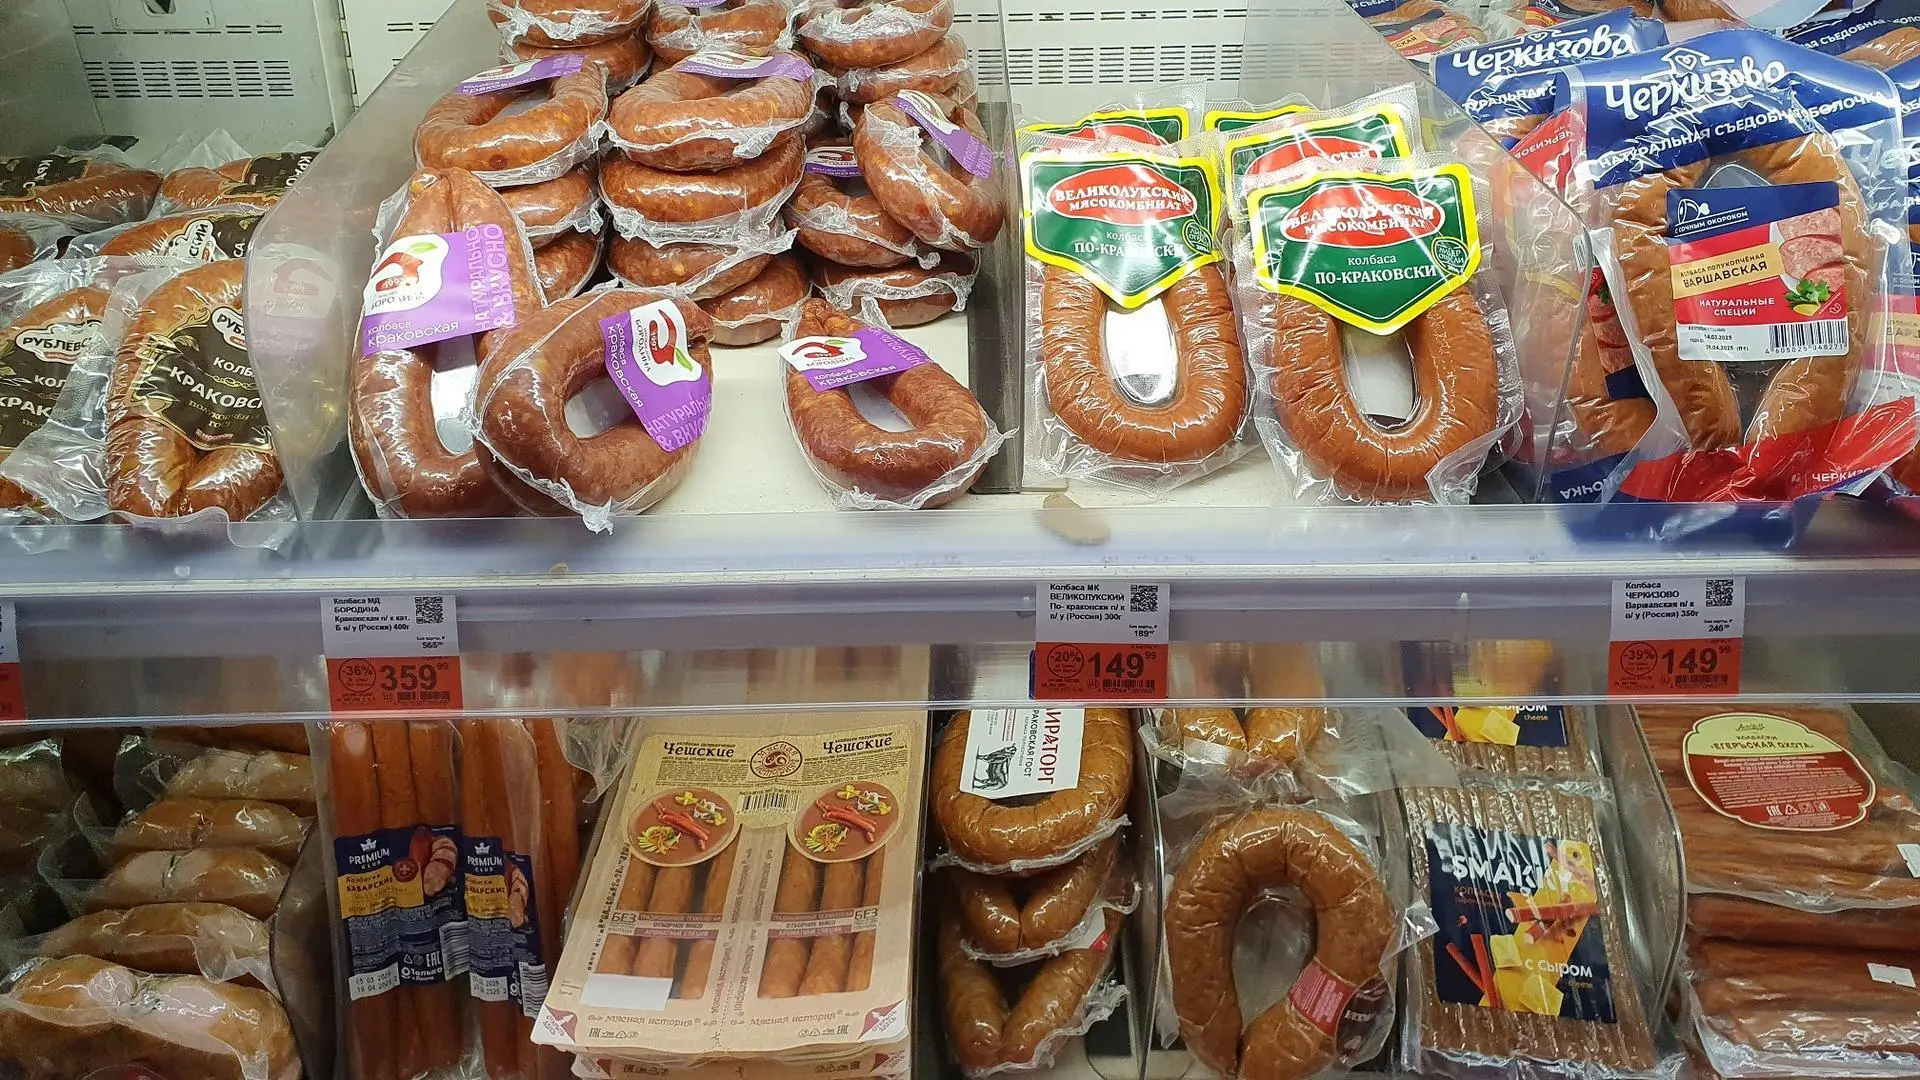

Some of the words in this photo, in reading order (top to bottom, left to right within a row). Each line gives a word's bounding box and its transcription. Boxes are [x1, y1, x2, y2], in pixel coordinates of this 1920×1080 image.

[1604, 56, 1786, 120] Черкизово
[1069, 197, 1182, 211] МЯСОКОМБИНАТ
[1707, 211, 1749, 227] ОКОРОКОМ
[1348, 254, 1397, 267] колбаса
[1314, 264, 1437, 285] ПО-КРАКОВСКИ
[1699, 297, 1775, 307] НАТУРАЛЬНЫЕ
[1714, 308, 1756, 317] СПЕЦИИ
[368, 321, 460, 347] краковская
[616, 322, 627, 366] колбаса
[608, 325, 644, 409] краковская
[818, 365, 897, 387] краковская
[1050, 583, 1085, 591] Колбаса
[1626, 581, 1661, 589] Колбаса
[1050, 592, 1125, 601] ВЕЛИКОЛУКСКИЙ
[1050, 603, 1065, 611] По-
[1066, 604, 1109, 612] краковски
[335, 615, 380, 623] Краковская
[1066, 613, 1103, 622] (Россия)
[1104, 613, 1123, 621] 300г
[1642, 611, 1679, 619] (Россия)
[358, 623, 392, 632] (Россия)
[1050, 652, 1082, 663] -20%
[1624, 649, 1655, 661] -39%
[1662, 647, 1718, 674] 149
[341, 665, 373, 677] -36%
[1087, 652, 1144, 679] 149
[1144, 651, 1157, 660] 99
[379, 664, 438, 691] 359
[663, 741, 735, 758] Чешские
[823, 734, 893, 755] Чешские
[1023, 757, 1035, 778] ГОСТ
[349, 847, 391, 866] PREMIUM
[467, 855, 503, 866] PREMIUM
[361, 860, 381, 870] CLUB
[611, 912, 637, 924] БЕЗ
[854, 908, 879, 921] БЕЗ
